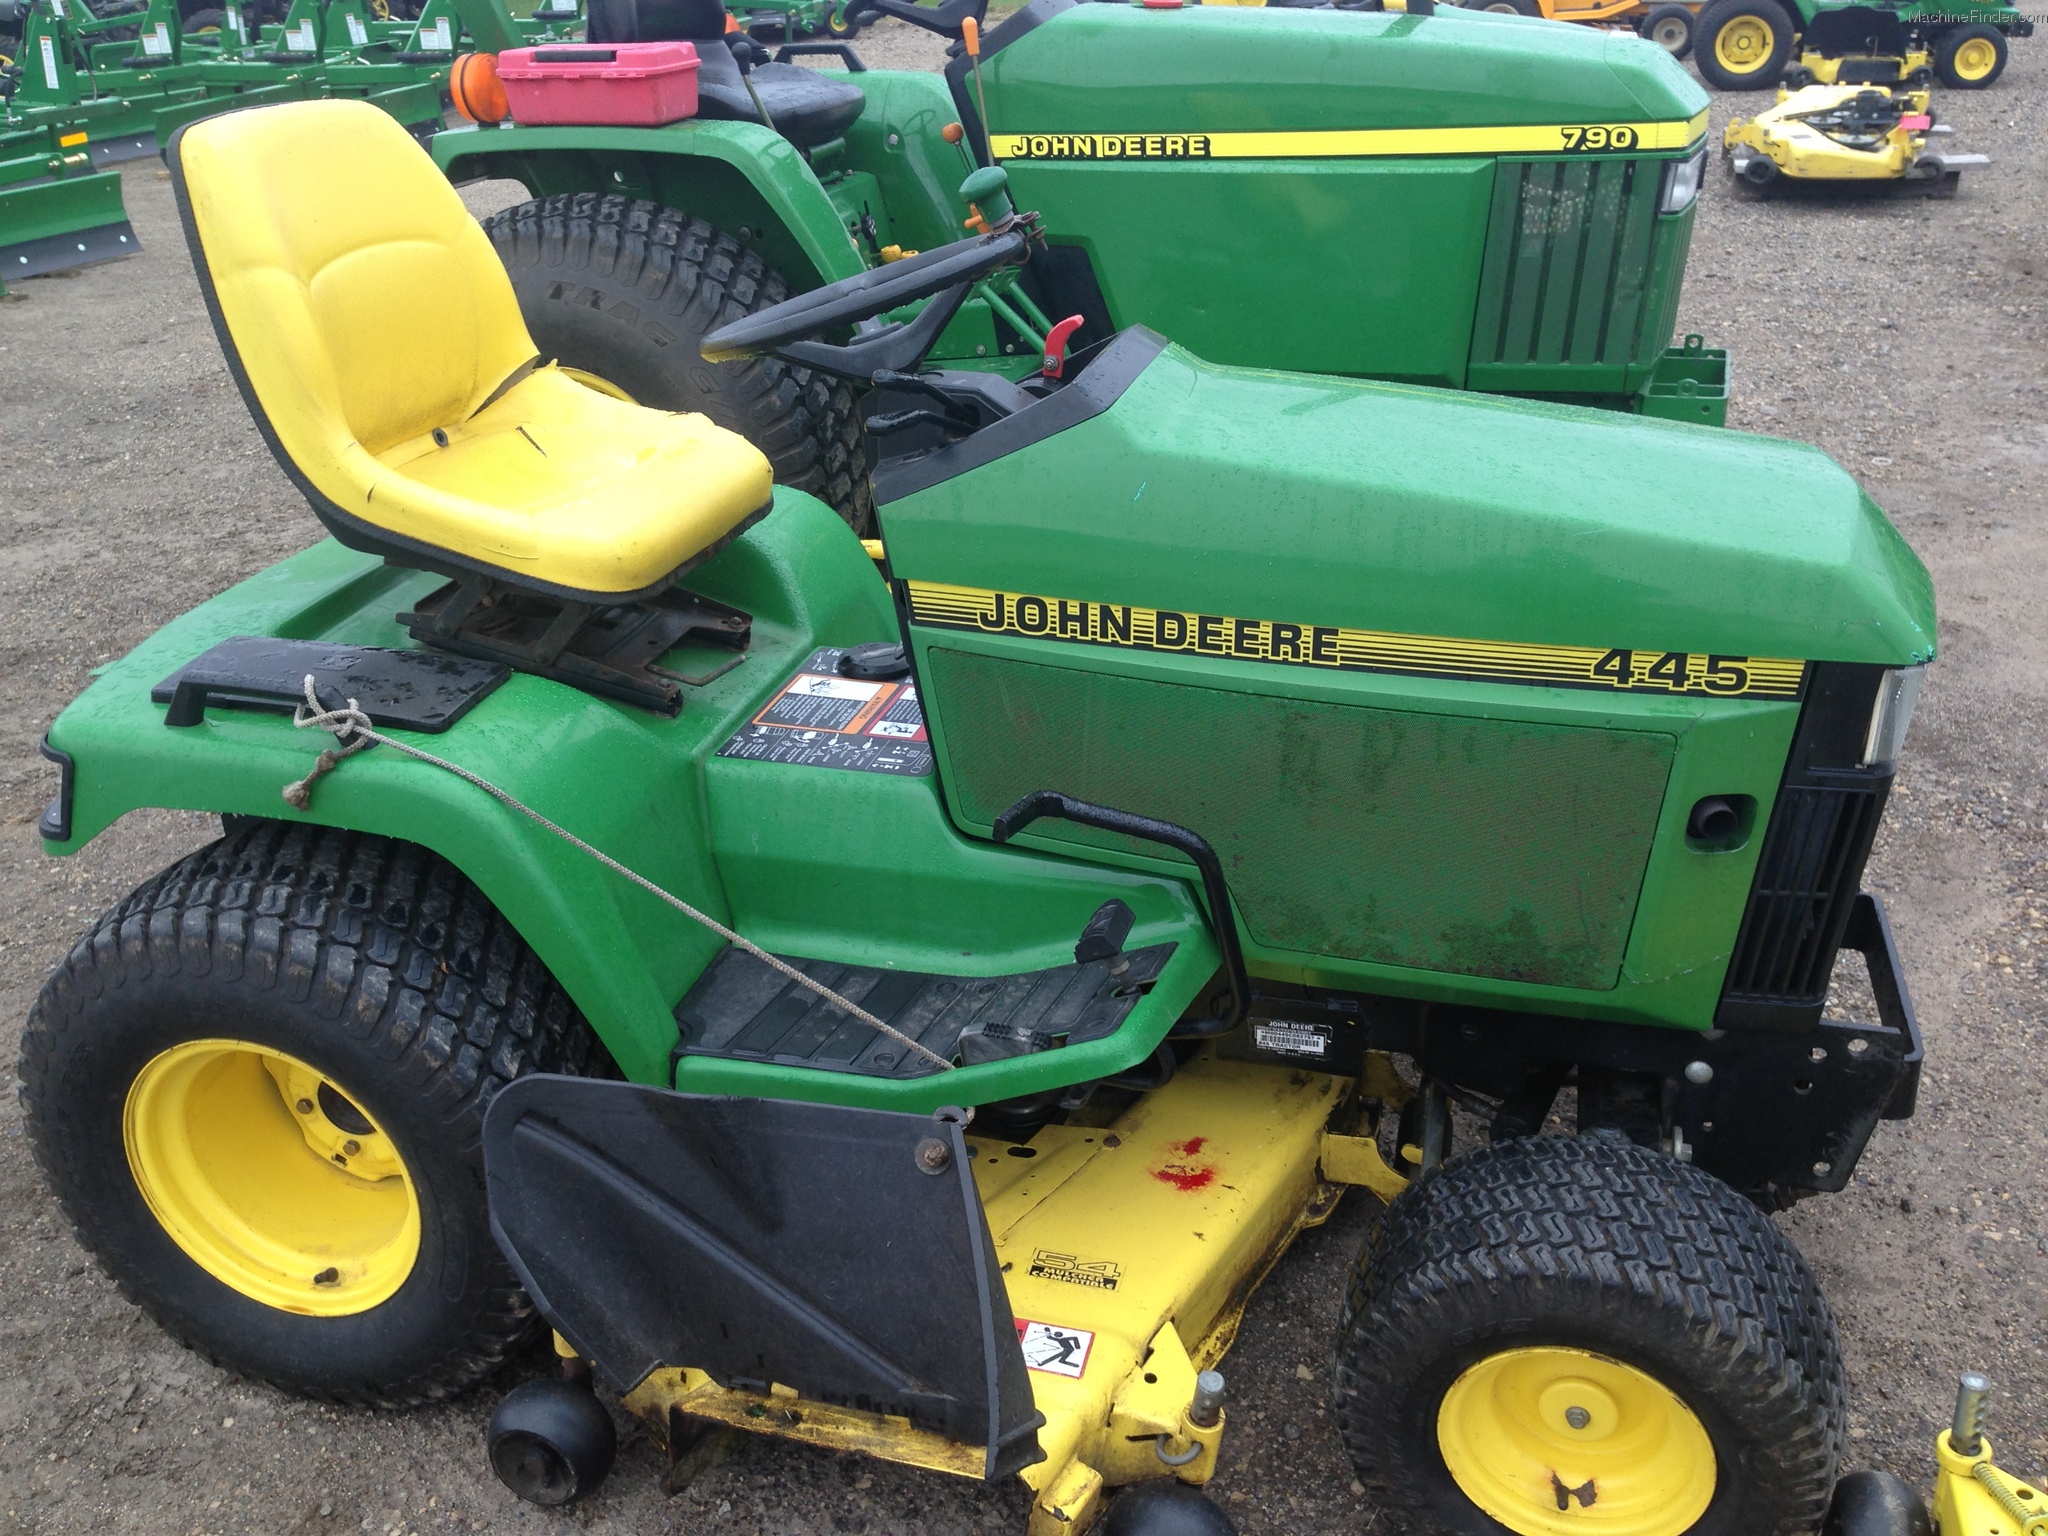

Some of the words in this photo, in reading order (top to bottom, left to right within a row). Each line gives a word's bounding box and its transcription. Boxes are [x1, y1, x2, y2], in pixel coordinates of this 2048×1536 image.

[1011, 135, 1099, 159] JOHN
[1101, 135, 1211, 159] DEERE
[1561, 126, 1639, 152] 790
[977, 593, 1134, 646] JOHN
[1152, 610, 1342, 667] DEERE
[1590, 647, 1751, 696] 445
[1268, 1021, 1289, 1029] JOHN
[1033, 1250, 1121, 1279] 54
[1043, 1267, 1104, 1283] MULCHER
[1031, 1270, 1114, 1290] COMPATIBLE
